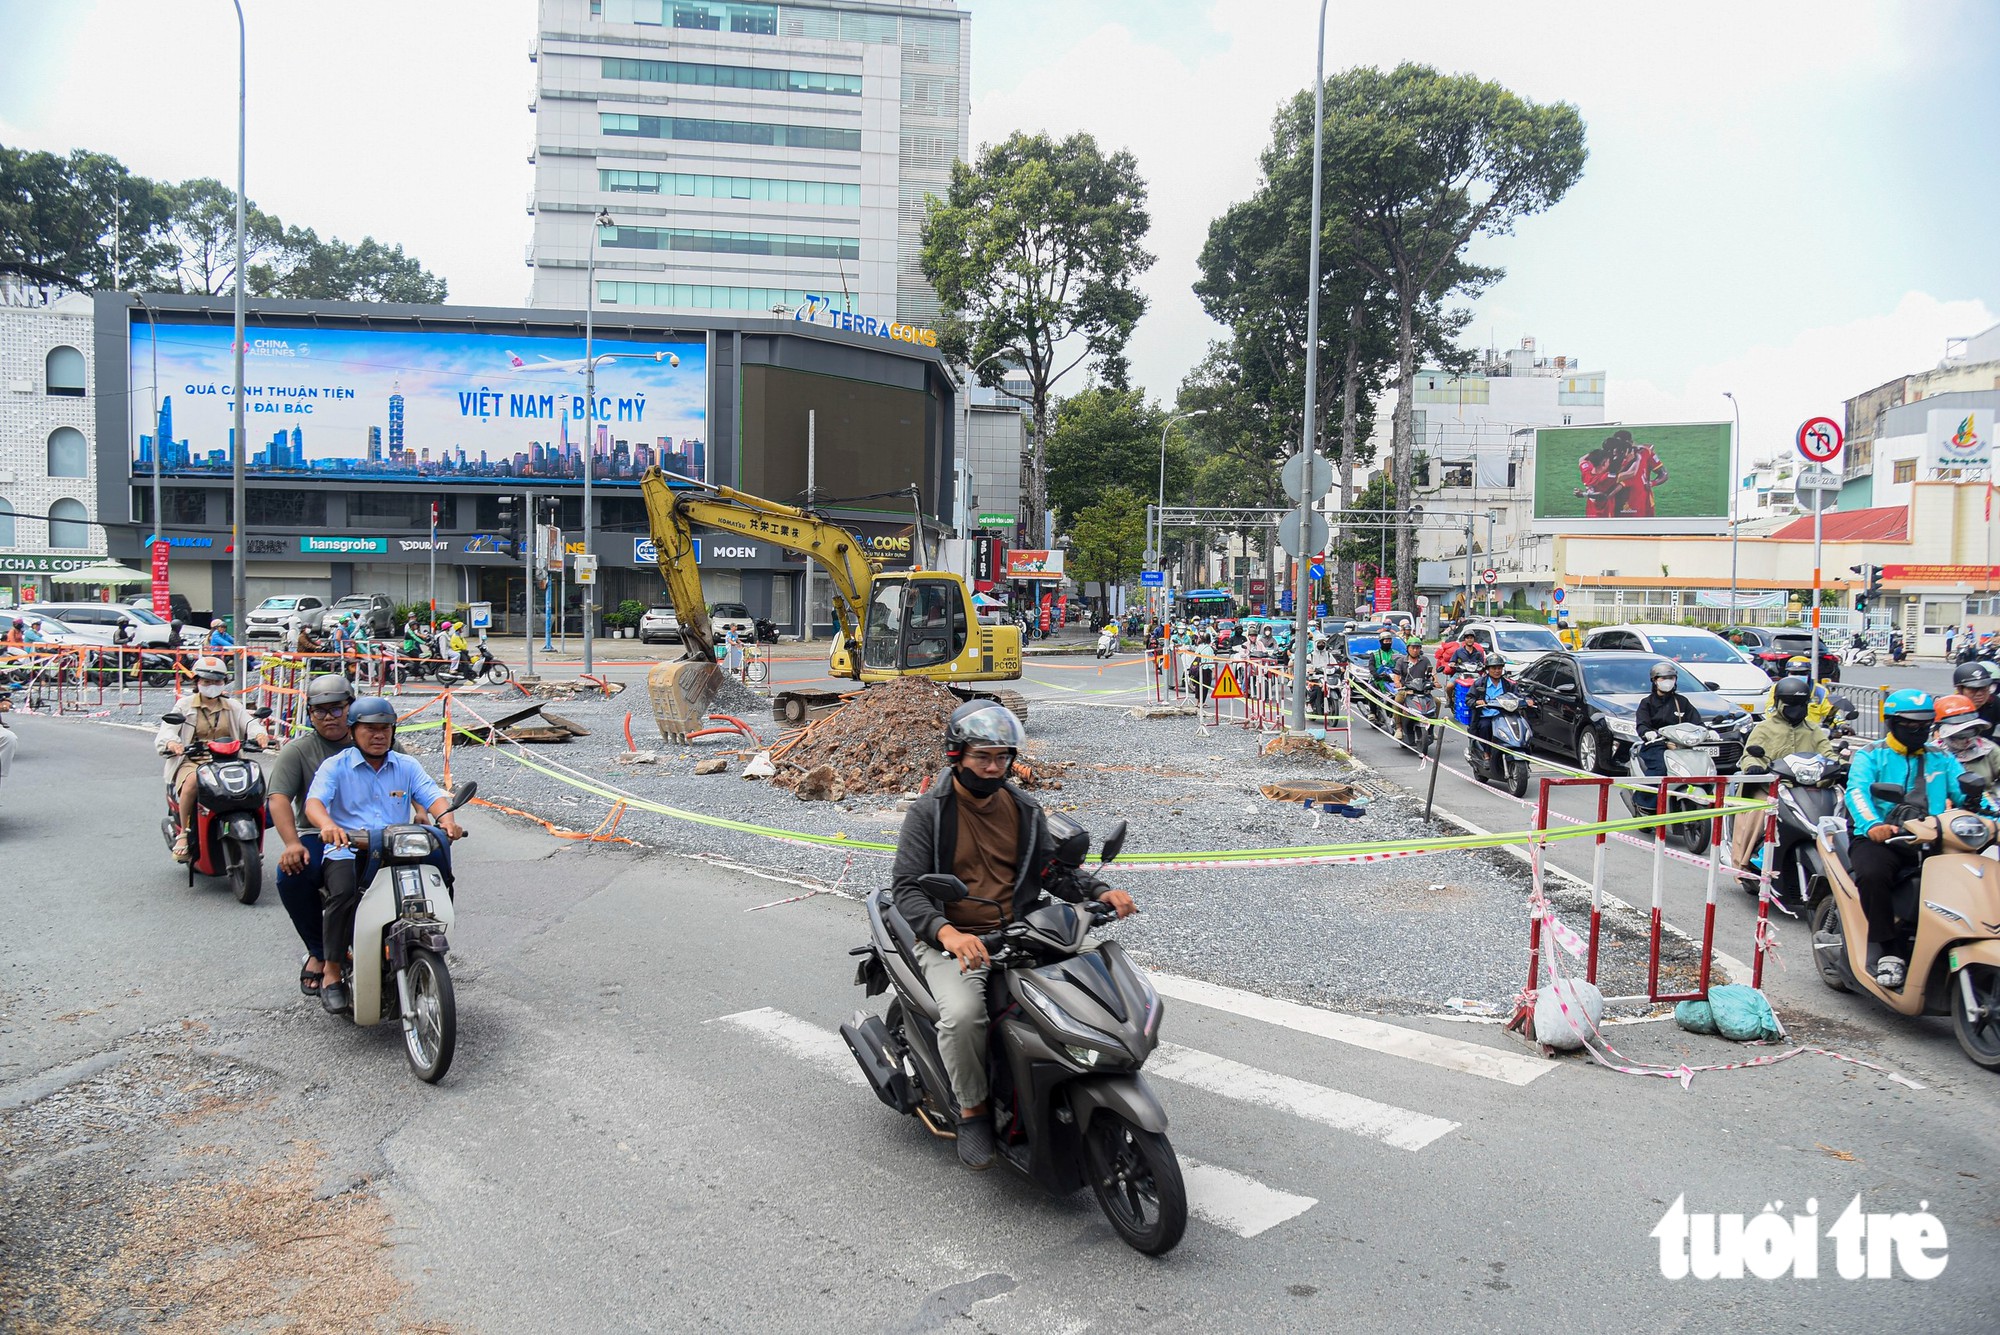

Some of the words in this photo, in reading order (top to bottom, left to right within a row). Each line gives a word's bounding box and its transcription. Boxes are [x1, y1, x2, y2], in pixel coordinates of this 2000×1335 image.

[829, 309, 937, 348] TERRACONS
[254, 339, 289, 349] CHINA
[249, 348, 296, 357] AIRLINES
[185, 382, 217, 395] QUÁ
[221, 385, 263, 396] CNH
[267, 385, 318, 400] THUẬN
[322, 386, 355, 401] TIỆN
[227, 402, 249, 412] TI
[254, 399, 279, 413] ĐÀI
[284, 400, 314, 414] BẮC
[458, 386, 504, 423] VIỆT
[510, 394, 554, 418] NAM
[618, 392, 646, 422] MỸ
[717, 517, 746, 529] KOMATSU
[309, 537, 377, 552] hansgrohe
[713, 546, 756, 558] MOEN
[38, 559, 49, 570] &
[52, 560, 97, 571] COFF
[994, 662, 1018, 670] PC120
